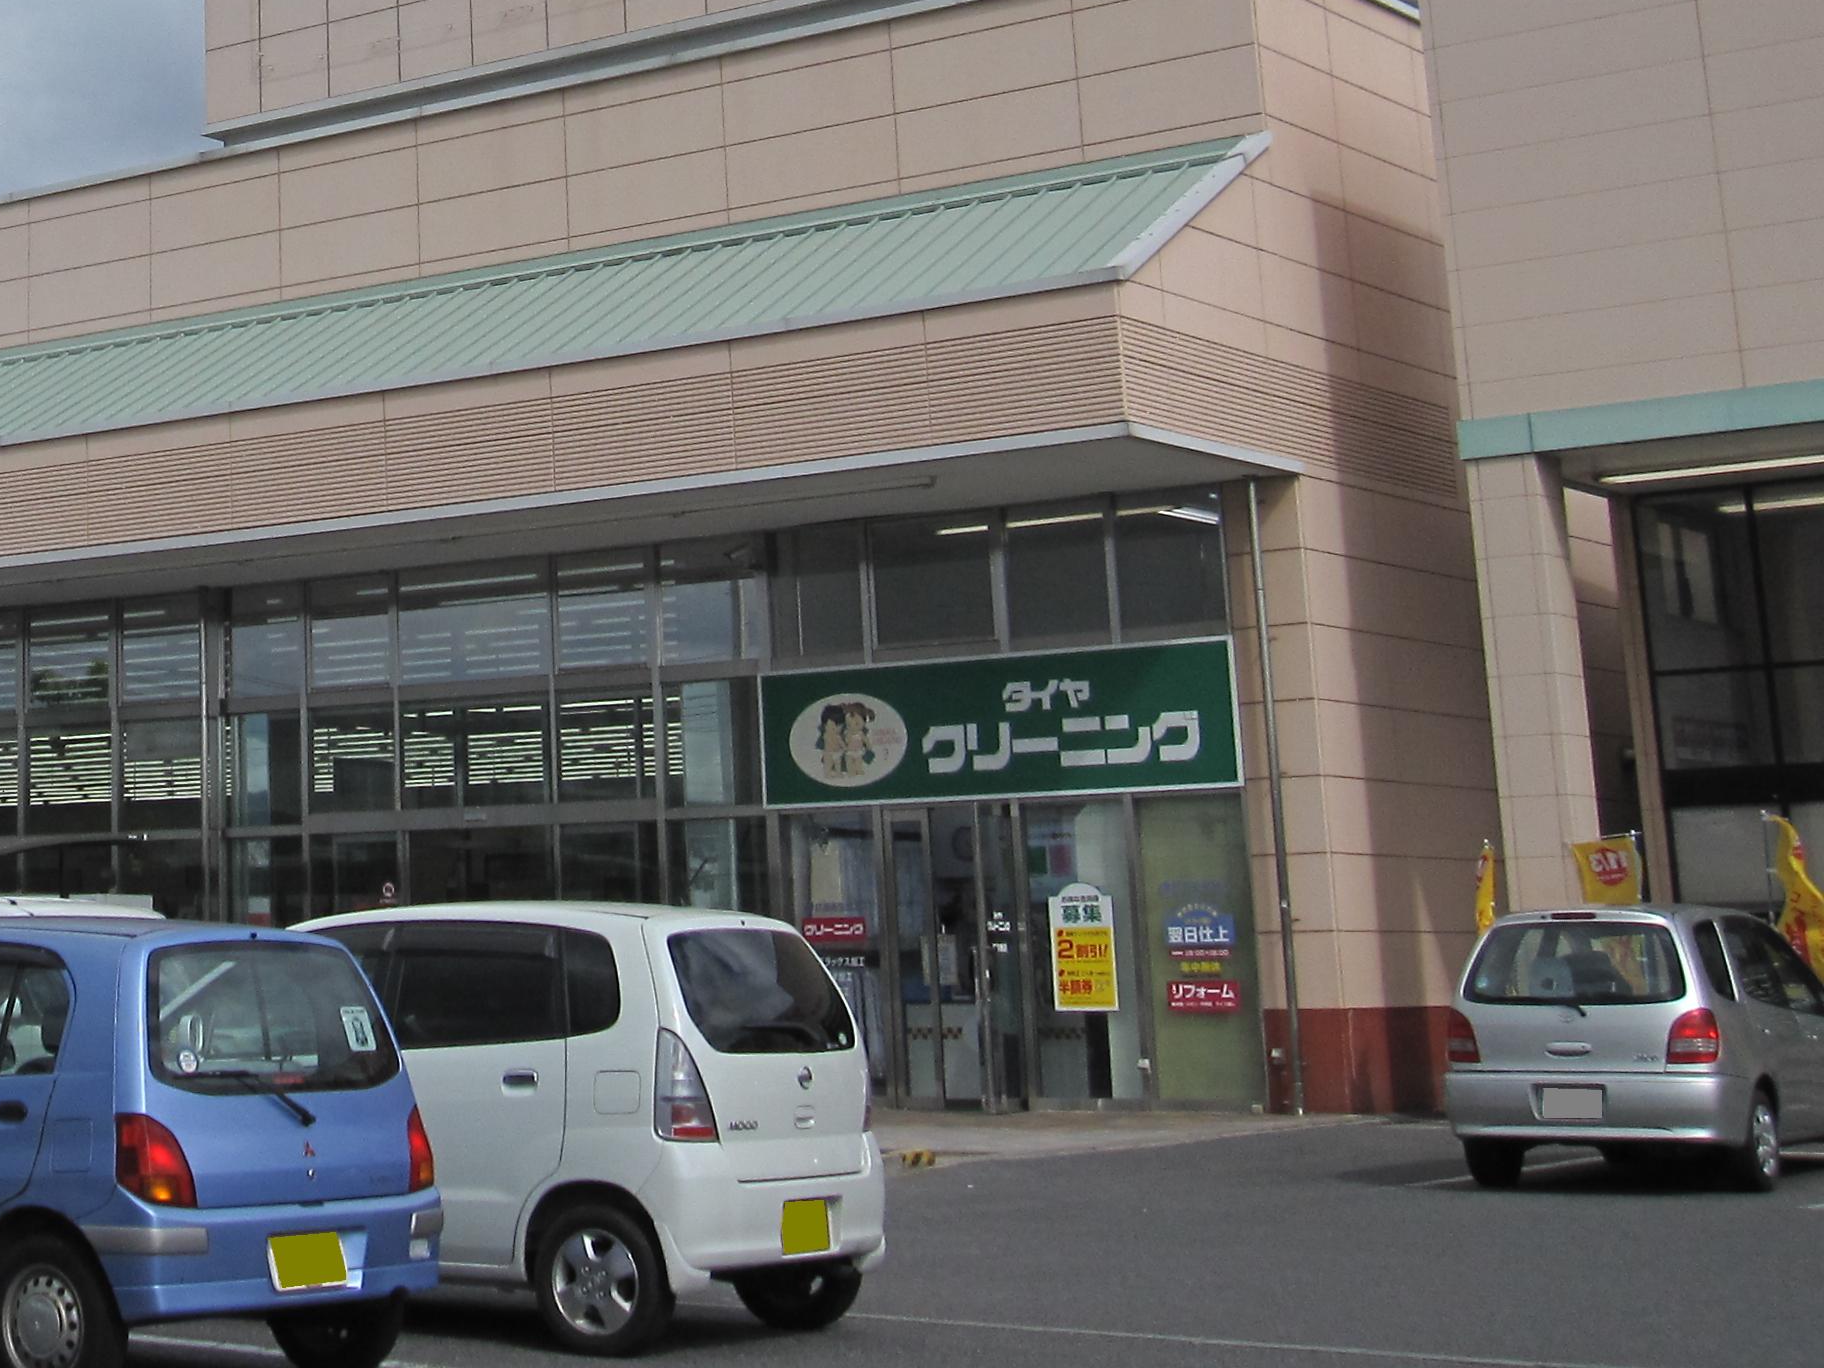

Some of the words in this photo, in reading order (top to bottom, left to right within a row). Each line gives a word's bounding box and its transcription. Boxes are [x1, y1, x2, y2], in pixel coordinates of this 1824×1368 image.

[922, 710, 1200, 774] クリーニング
[803, 923, 864, 936] クリーニング
[1168, 926, 1230, 943] 翌日仕上
[1171, 984, 1235, 999] リフォーム
